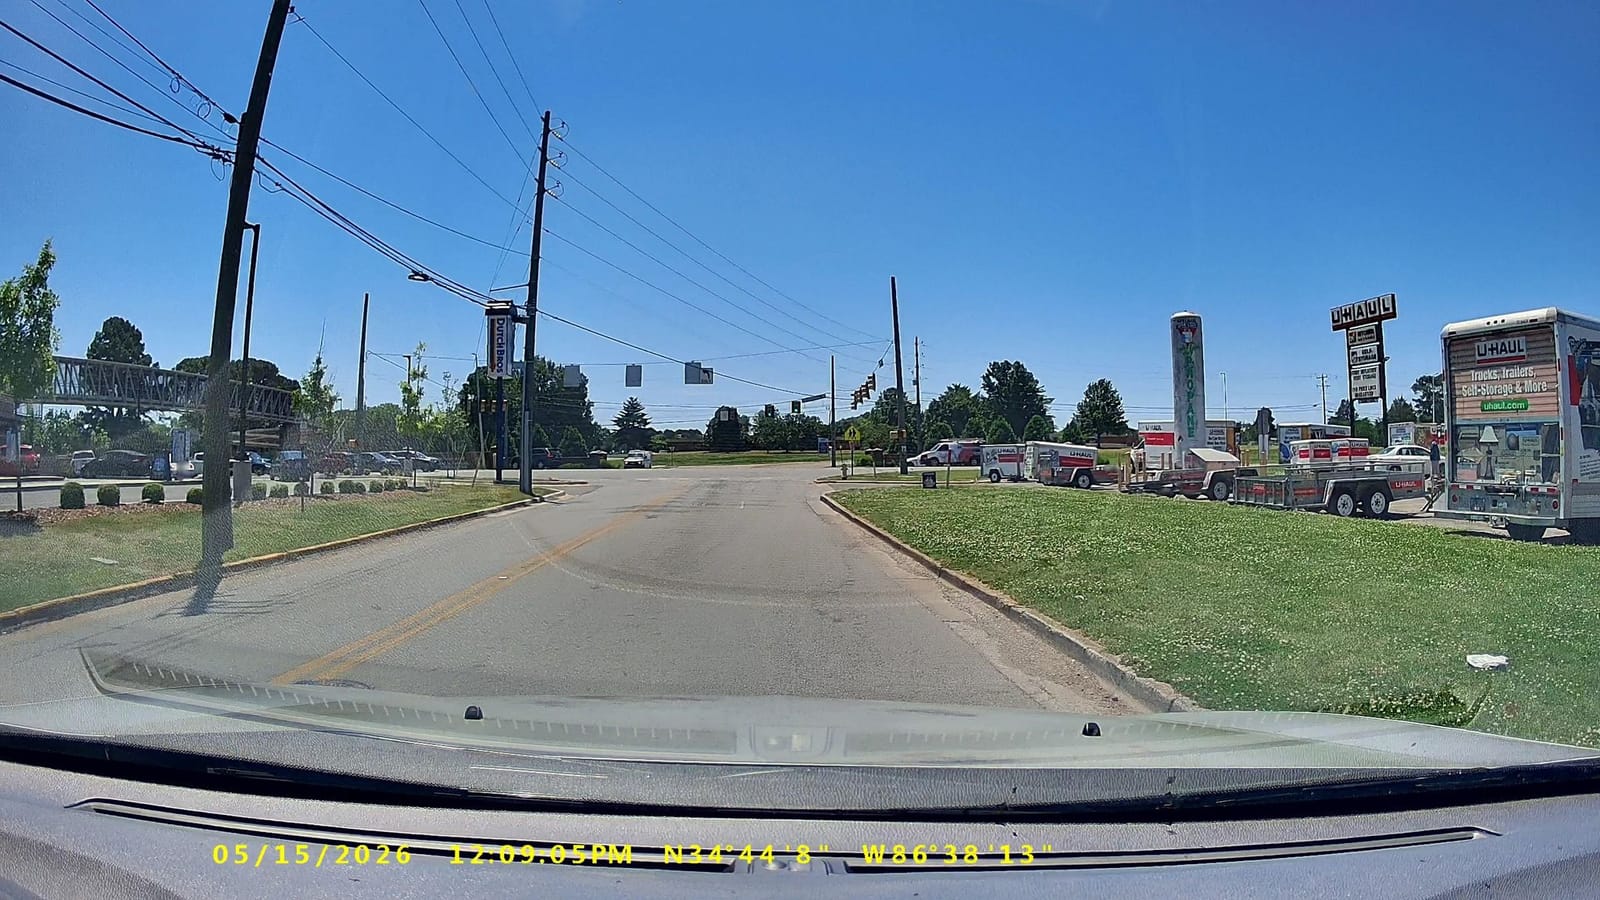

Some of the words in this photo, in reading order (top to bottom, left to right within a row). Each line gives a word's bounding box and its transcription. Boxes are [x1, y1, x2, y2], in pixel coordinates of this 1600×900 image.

[497, 318, 505, 349] DUTCH
[1477, 339, 1524, 356] U-HAUL
[497, 350, 505, 373] BROS
[1471, 368, 1500, 382] Trucks,
[1503, 365, 1537, 380] Trailers,
[1462, 383, 1513, 396] Self-Storage
[1515, 383, 1522, 393] &
[1525, 380, 1548, 392] More
[1484, 401, 1526, 411] uhaul.com
